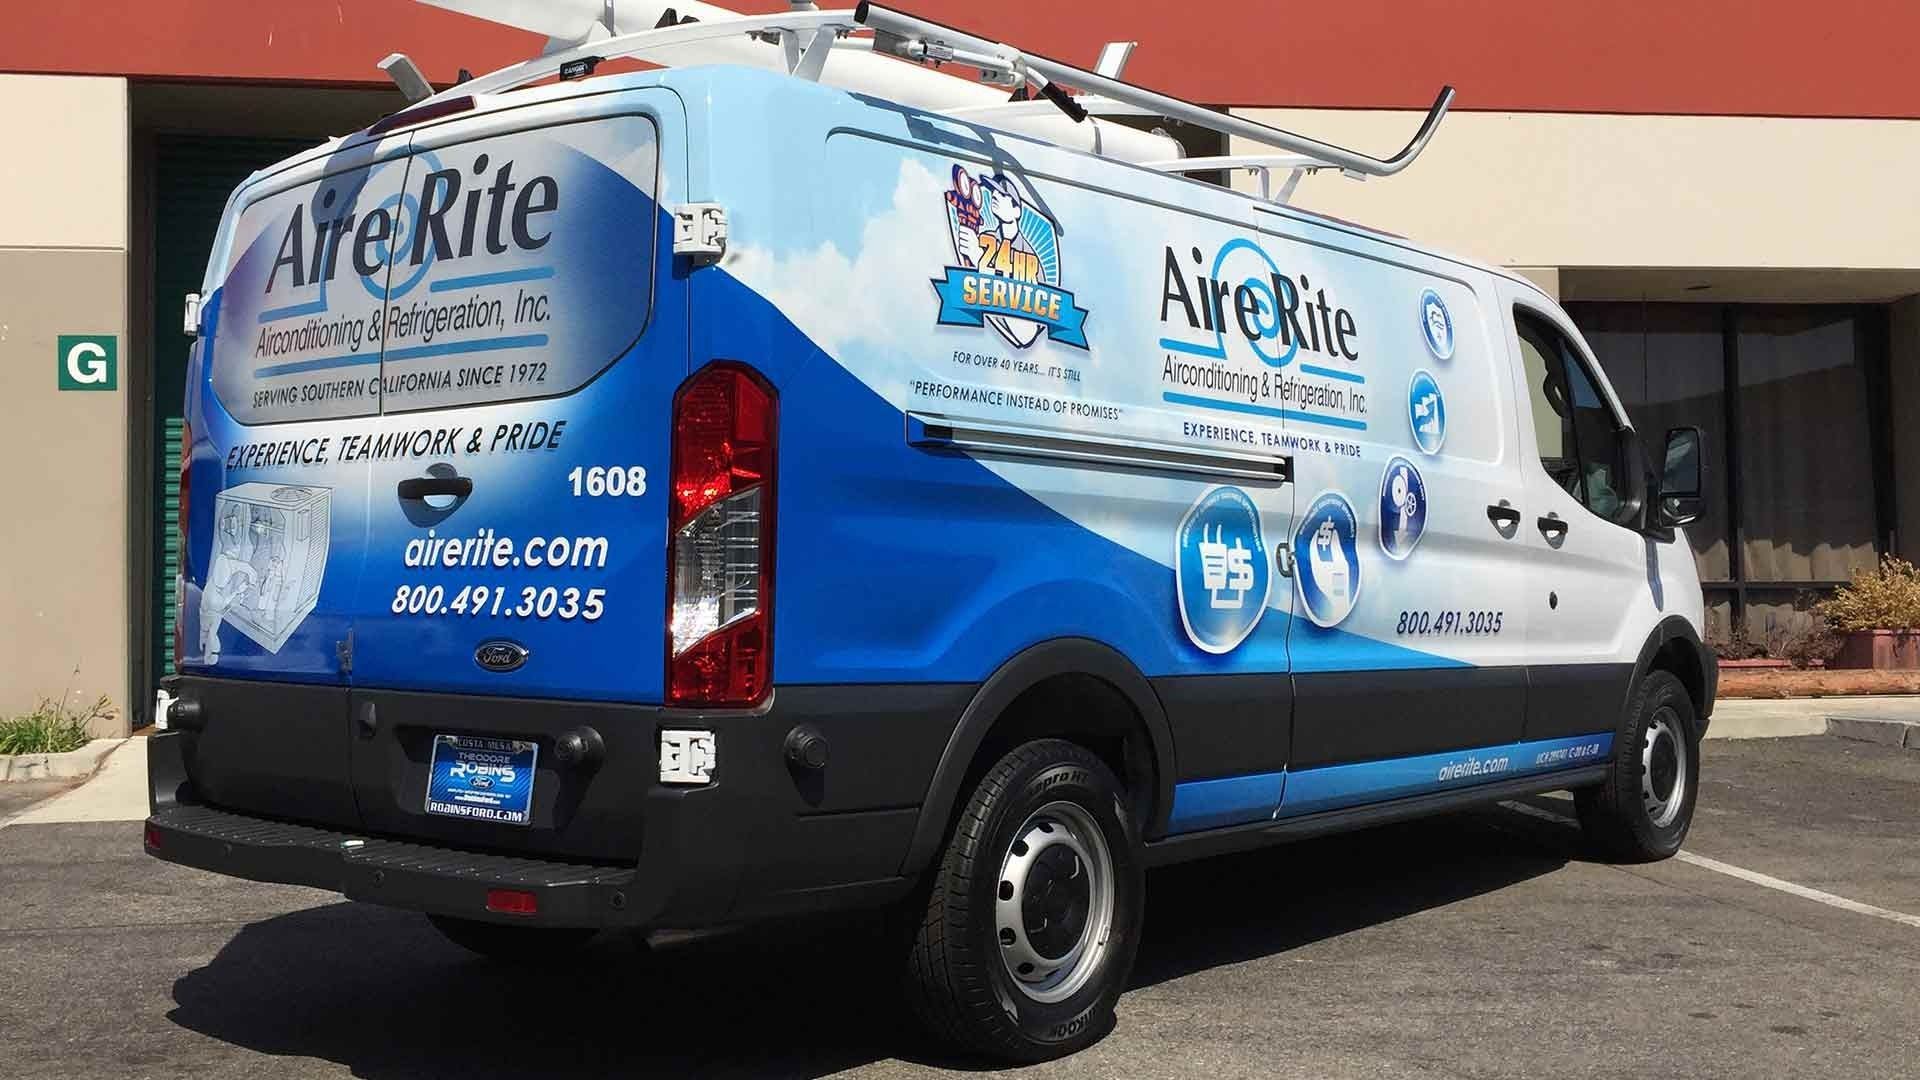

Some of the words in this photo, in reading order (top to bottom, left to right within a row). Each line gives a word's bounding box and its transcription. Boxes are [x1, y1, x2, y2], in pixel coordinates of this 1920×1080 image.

[265, 188, 392, 294] Aire
[409, 153, 559, 266] Rite
[963, 276, 1062, 320] SERVICE
[1161, 246, 1262, 341] Aire
[1270, 272, 1359, 361] Rite
[256, 313, 364, 358] Airconditioning
[367, 309, 382, 342] &
[386, 294, 504, 343] Refrigeration,
[514, 288, 551, 324] Inc.
[67, 342, 107, 384] G
[953, 351, 971, 365] FOR
[973, 354, 998, 369] OVER
[1000, 359, 1011, 371] 40
[1063, 368, 1081, 382] STILL
[253, 386, 298, 408] SERVING
[301, 378, 365, 402] SOUTHERN
[369, 370, 452, 396] CALIFORNIA
[457, 364, 504, 388] SINCE
[509, 362, 547, 383] 1972
[910, 380, 1003, 406] "PERFORMANCE
[1006, 394, 1050, 411] INSTEAD
[1053, 400, 1067, 413] OF
[1162, 354, 1258, 403] Airconditioning
[1261, 371, 1271, 398] &
[1274, 373, 1345, 413] Refrigeration,
[1349, 386, 1367, 413] Inc.
[226, 437, 330, 470] EXPERIENCE,
[337, 427, 463, 462] TEAMWORK
[465, 427, 483, 454] &
[490, 420, 567, 452] PRIDE
[1183, 421, 1258, 446] EXPERIENCE,
[1261, 432, 1320, 452] TEAMWORK
[1324, 441, 1331, 453] &
[1334, 442, 1361, 458] PRIDE
[568, 466, 647, 497] 1608
[404, 528, 609, 568] airerite.com
[391, 584, 606, 620] 800.491.3035
[1396, 610, 1503, 635] 800.491.3035
[449, 760, 517, 784] ROBINS
[457, 751, 511, 764] THEODORE
[1438, 757, 1509, 782] airerite.com
[430, 801, 523, 823] ROBINSFORD.COM
